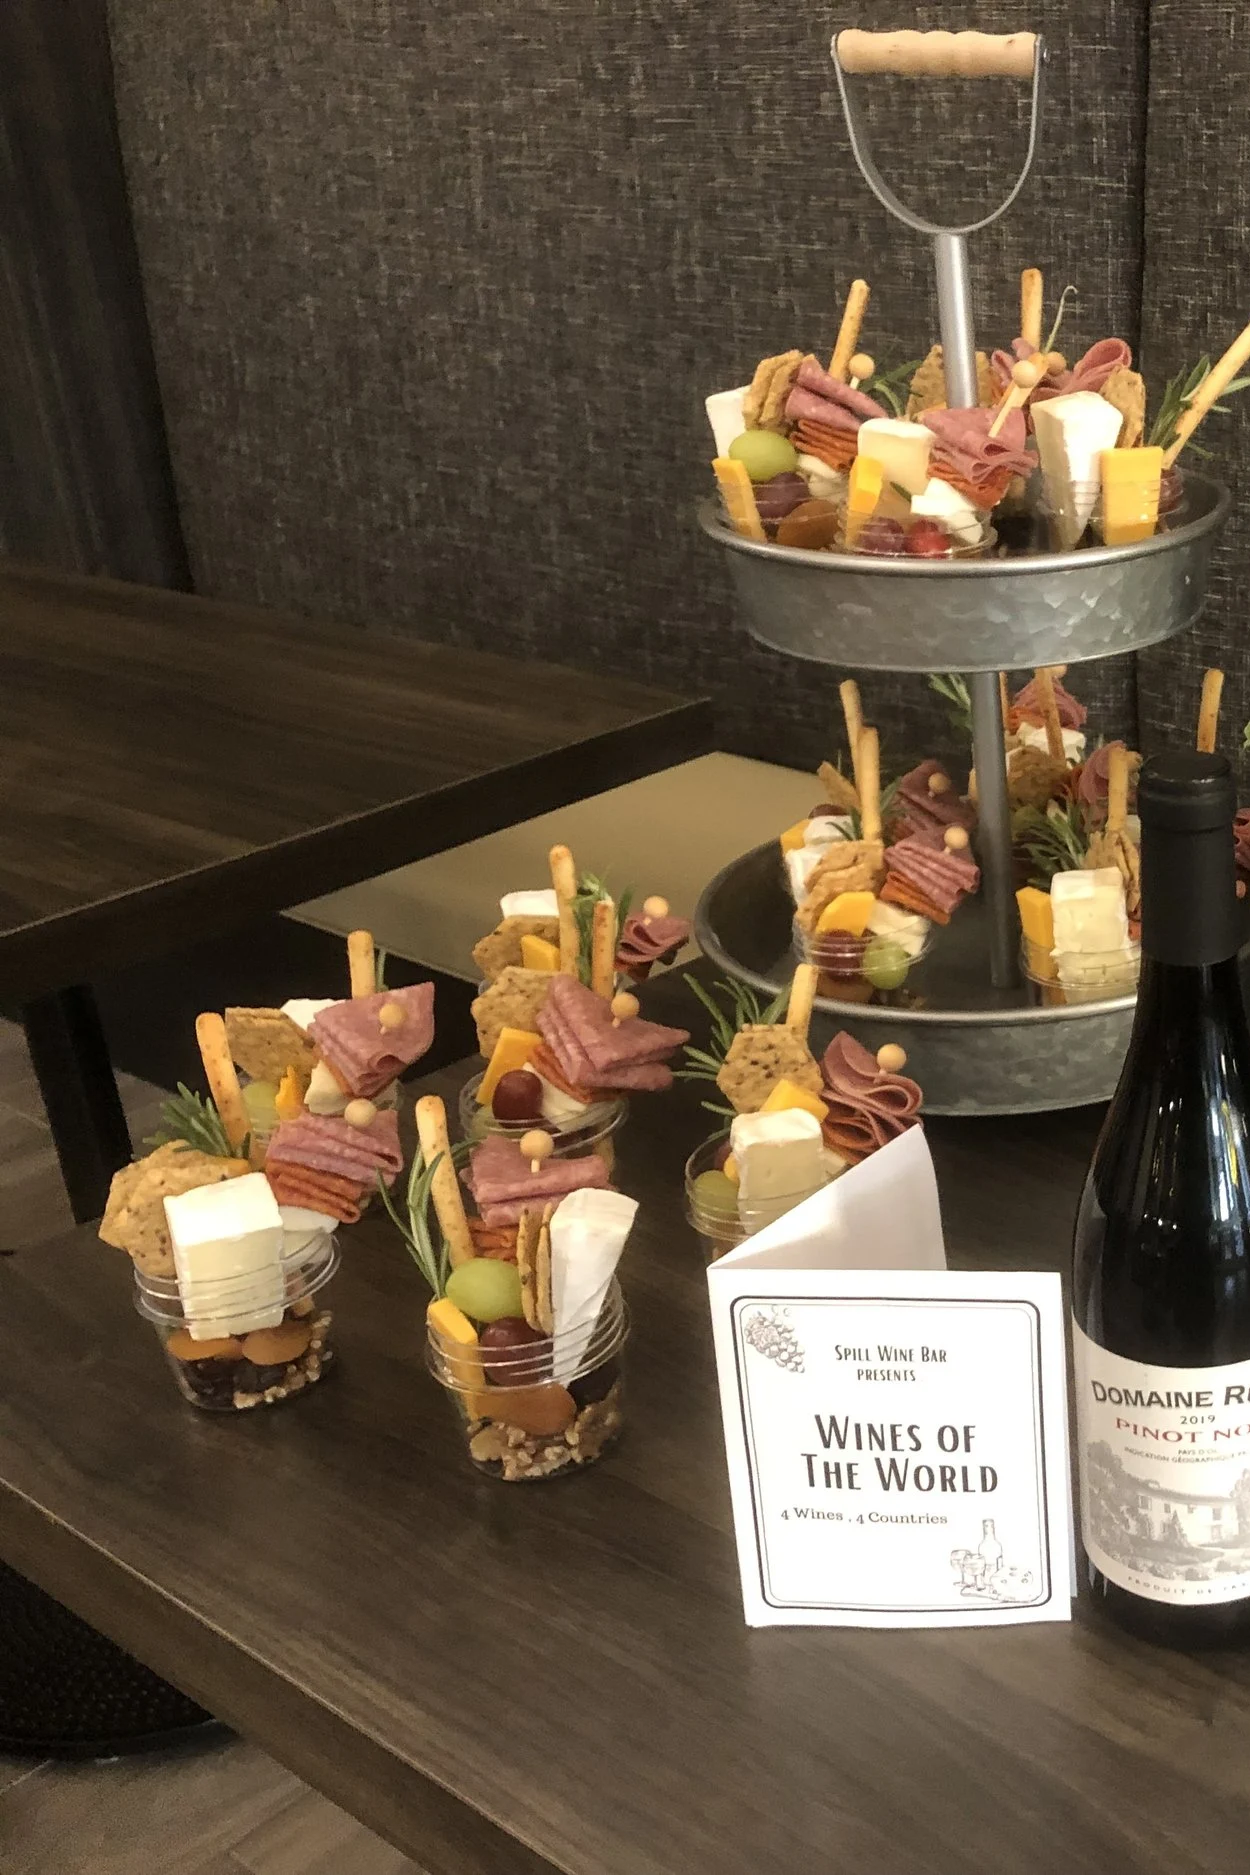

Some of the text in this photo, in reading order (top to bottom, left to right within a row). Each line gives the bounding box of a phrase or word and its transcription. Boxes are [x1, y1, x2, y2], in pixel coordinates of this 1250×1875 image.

[834, 1344, 947, 1363] SPILL WINE BAR
[857, 1368, 916, 1382] PRESENTS
[1091, 1379, 1214, 1408] DOMAINE
[1115, 1416, 1203, 1443] PINOT
[1180, 1414, 1216, 1425] 2019
[814, 1413, 976, 1453] WINES OF
[801, 1453, 998, 1493] THE WORLD
[780, 1508, 790, 1520] 4
[793, 1506, 844, 1521] Wines
[856, 1513, 865, 1524] 4
[868, 1511, 948, 1525] Countries
